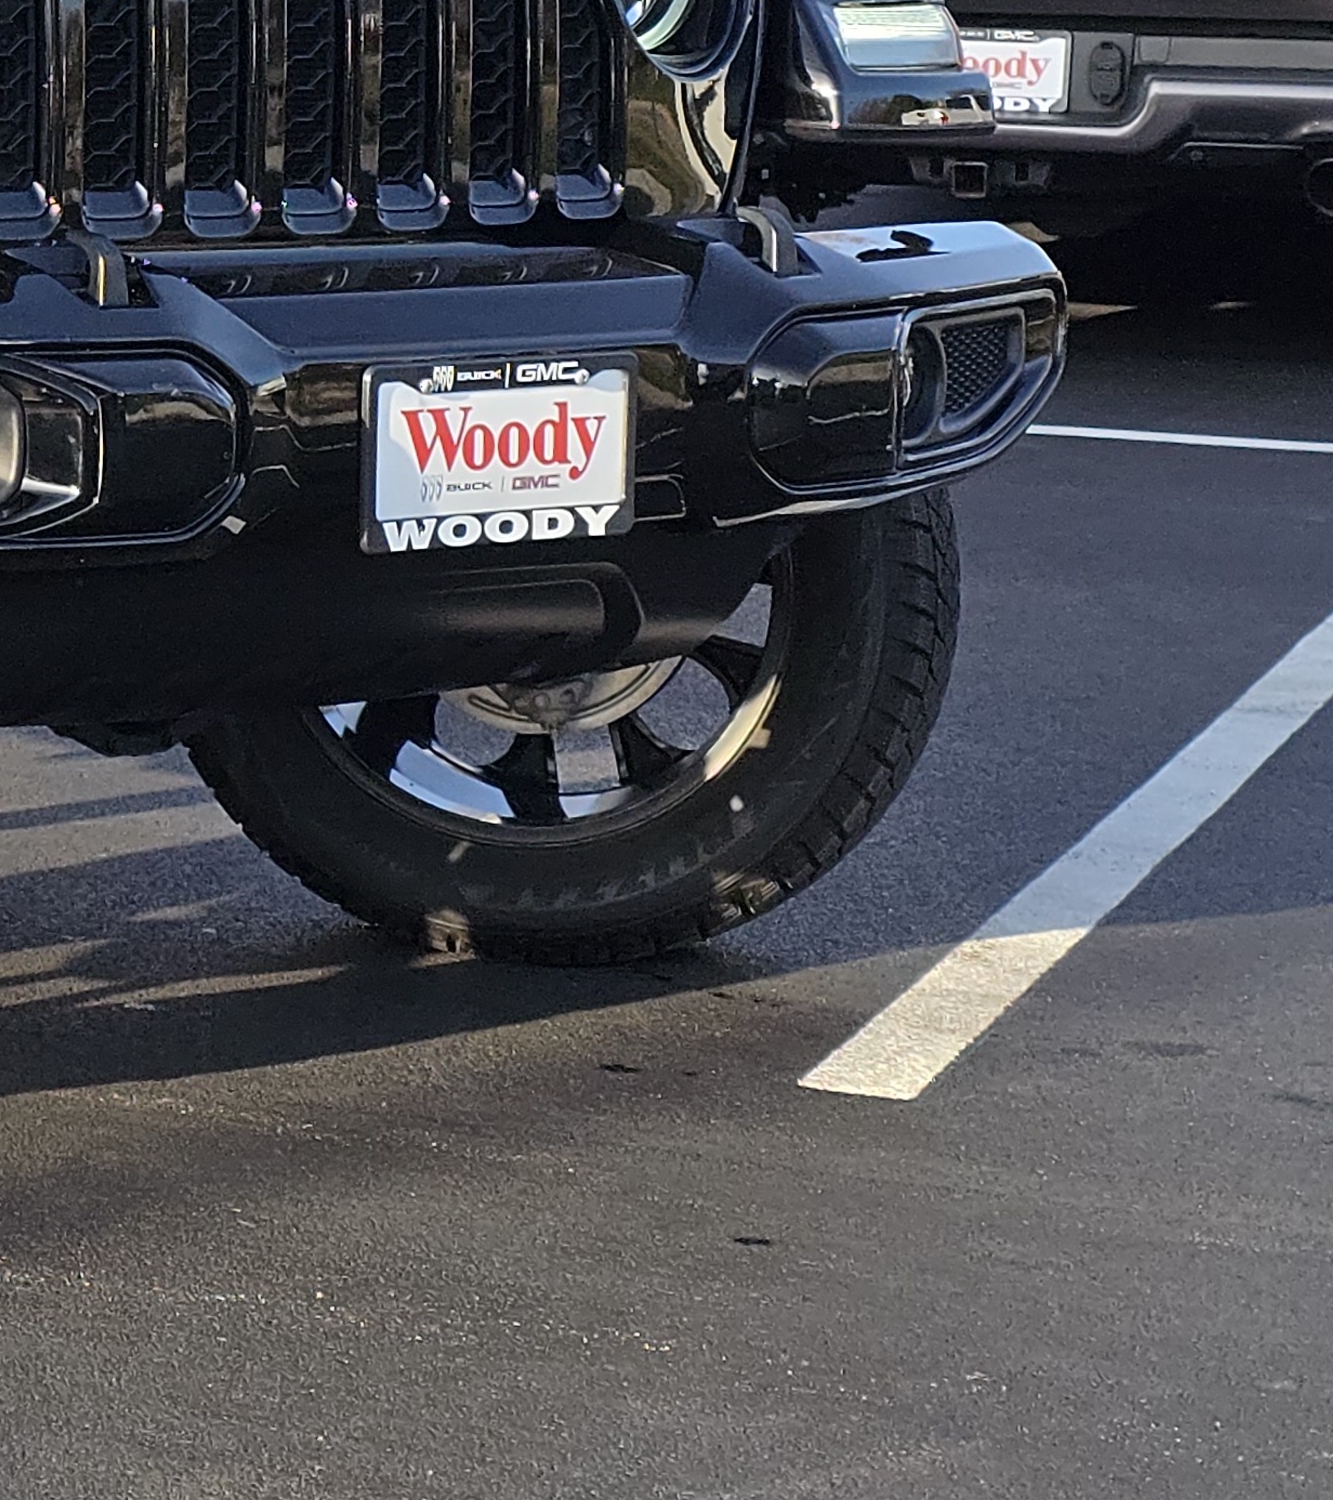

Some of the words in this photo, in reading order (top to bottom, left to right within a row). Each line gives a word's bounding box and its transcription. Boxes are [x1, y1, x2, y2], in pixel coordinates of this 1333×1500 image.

[963, 50, 1052, 87] oody
[457, 369, 502, 381] BUICK
[516, 361, 579, 382] GMC
[401, 402, 606, 480] Woody
[446, 481, 493, 492] BUICK
[511, 474, 561, 491] GMC
[382, 504, 621, 553] WOODY
